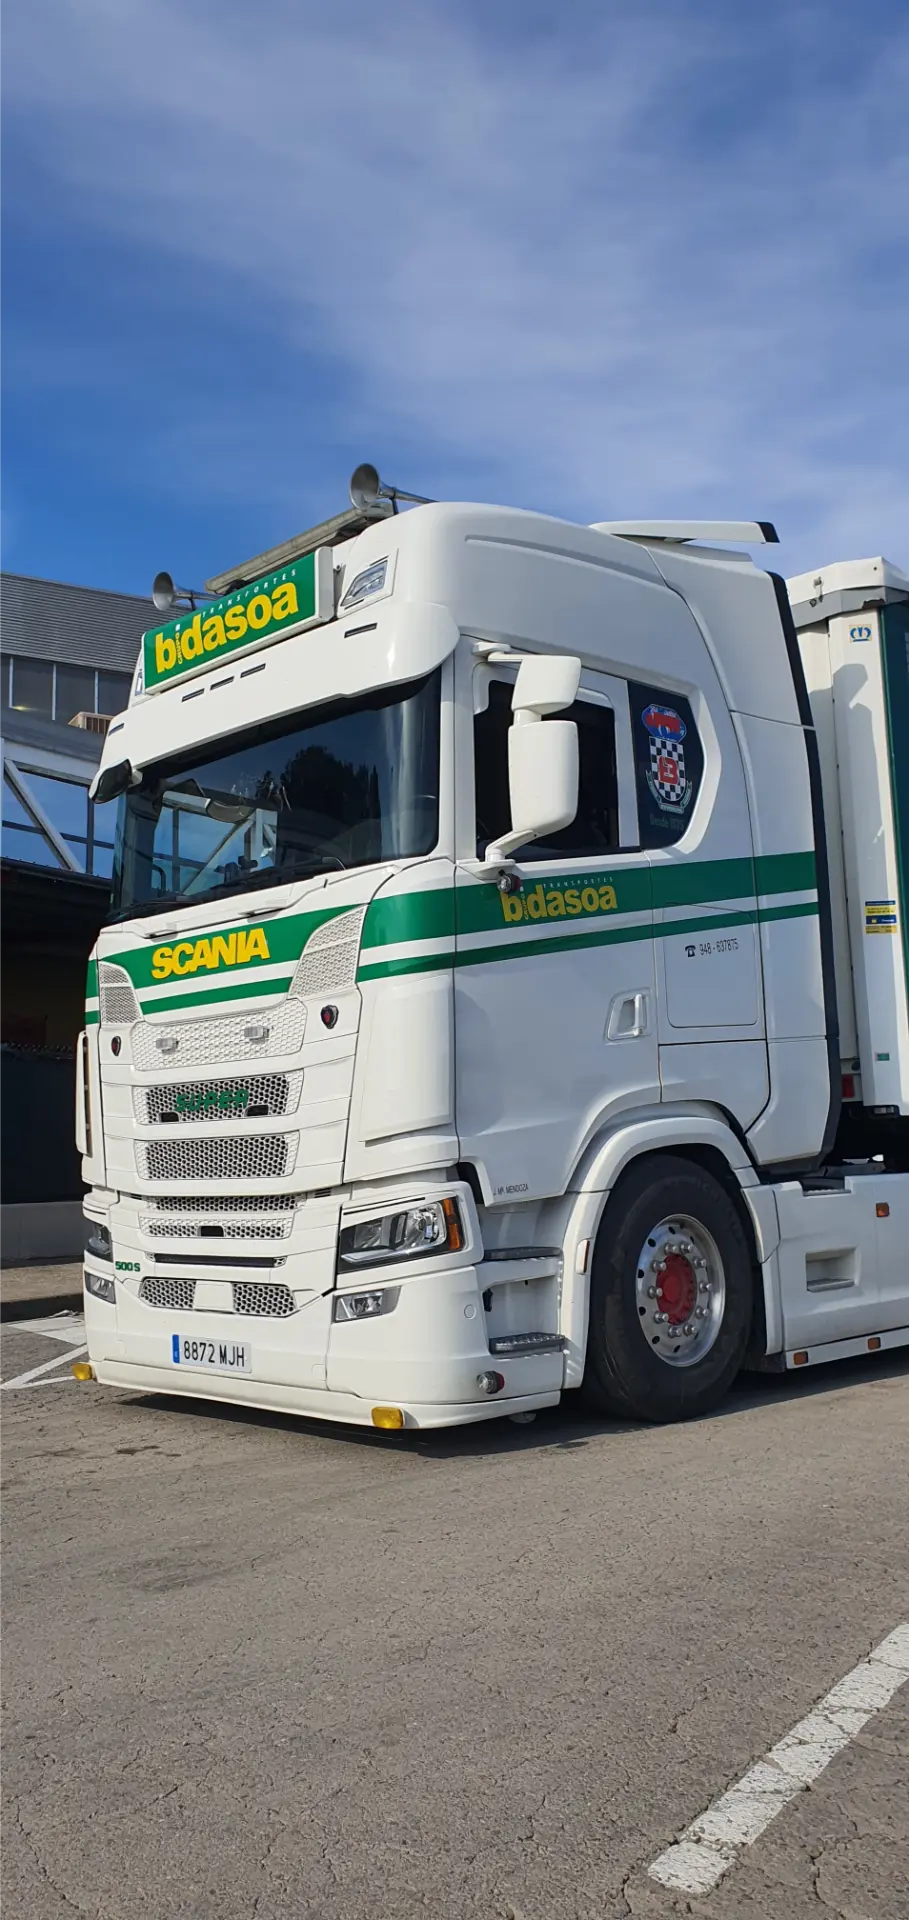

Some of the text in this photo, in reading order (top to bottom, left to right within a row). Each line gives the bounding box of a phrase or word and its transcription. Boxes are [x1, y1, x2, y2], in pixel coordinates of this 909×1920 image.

[155, 582, 299, 674] bidasoa
[151, 927, 270, 979] SCANIA
[174, 1088, 249, 1112] SUPER
[183, 1340, 245, 1367] 8872 MJH
